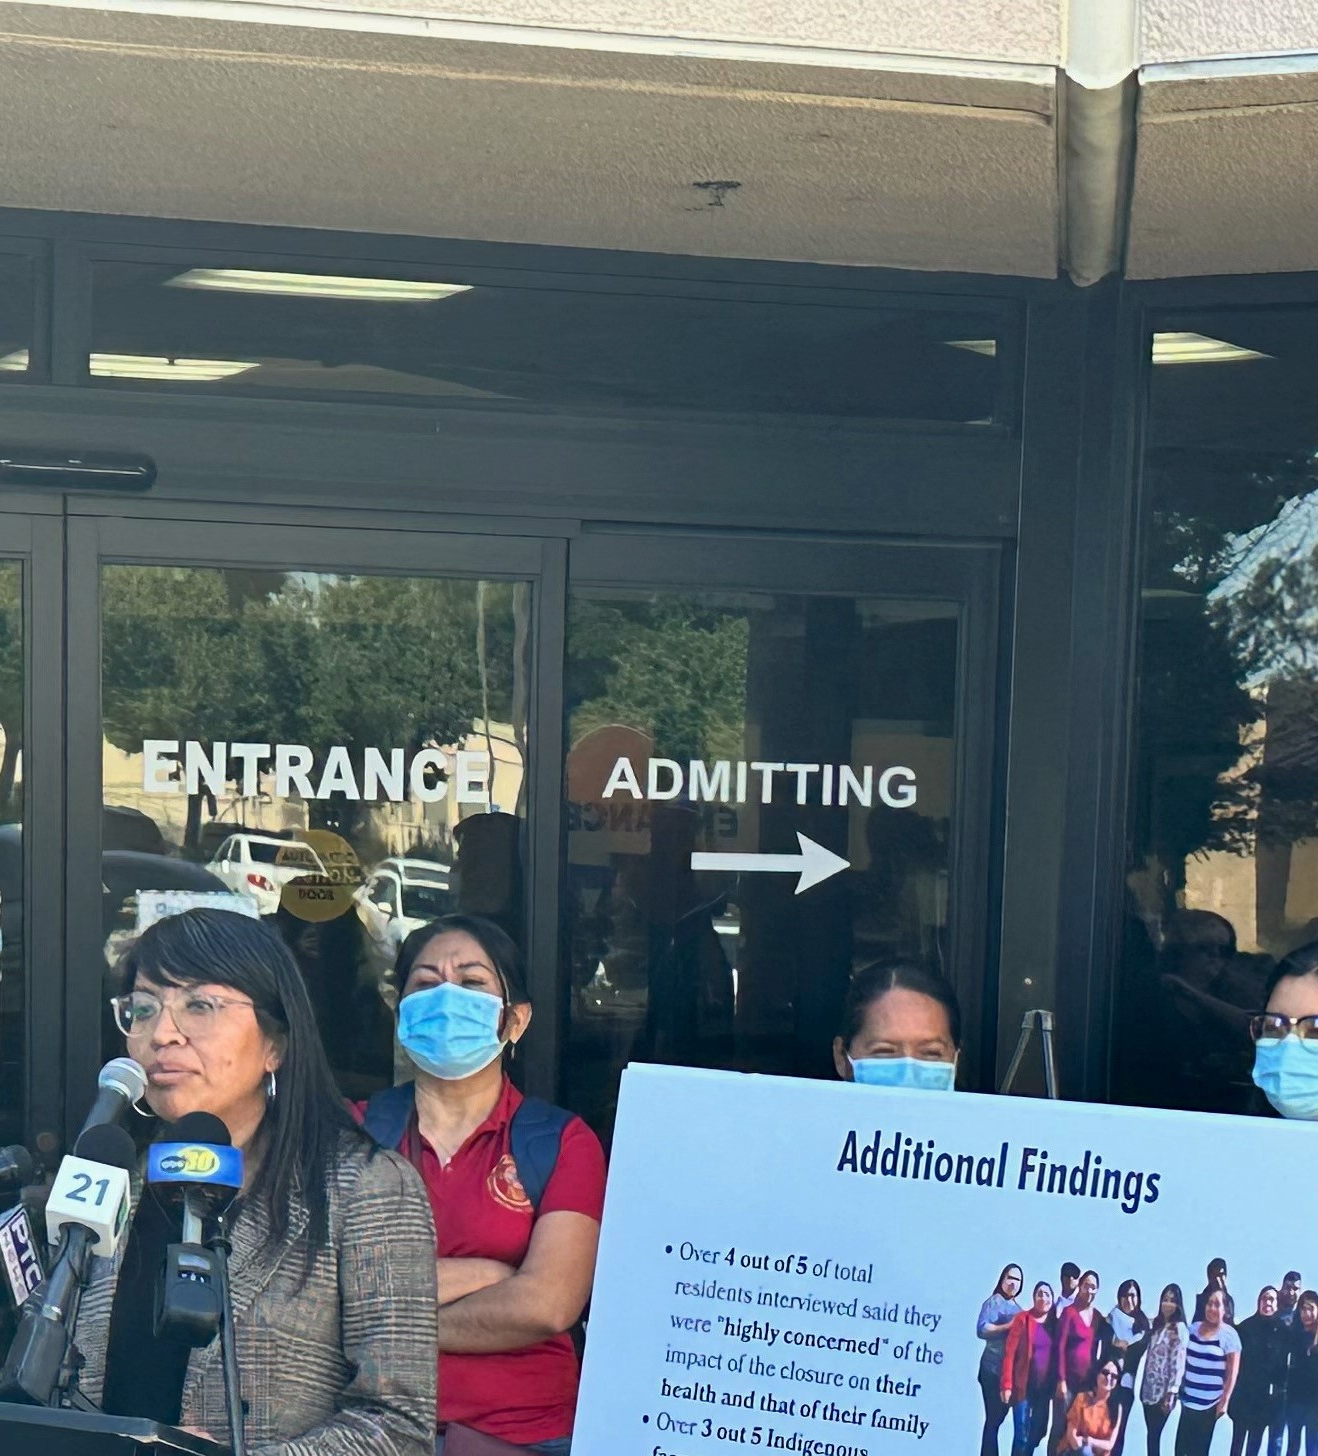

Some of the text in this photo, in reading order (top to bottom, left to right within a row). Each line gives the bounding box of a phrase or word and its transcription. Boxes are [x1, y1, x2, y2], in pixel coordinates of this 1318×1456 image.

[143, 739, 490, 803] ENTRANCE
[601, 757, 918, 809] ADMITTING
[65, 1172, 110, 1206] 21
[837, 1129, 1161, 1215] Additional Findings
[11, 1215, 42, 1295] PTC
[680, 1241, 873, 1284] Over 4 out of 5 of total
[675, 1279, 942, 1332] residents interviewed said they
[670, 1314, 944, 1365] were "highly concerned" of the
[665, 1344, 921, 1397] impact of the closure on their
[656, 1411, 697, 1435] Over
[701, 1418, 712, 1437] 3
[717, 1425, 746, 1443] out
[750, 1426, 762, 1445] 5
[661, 1378, 930, 1440] health and that of their family
